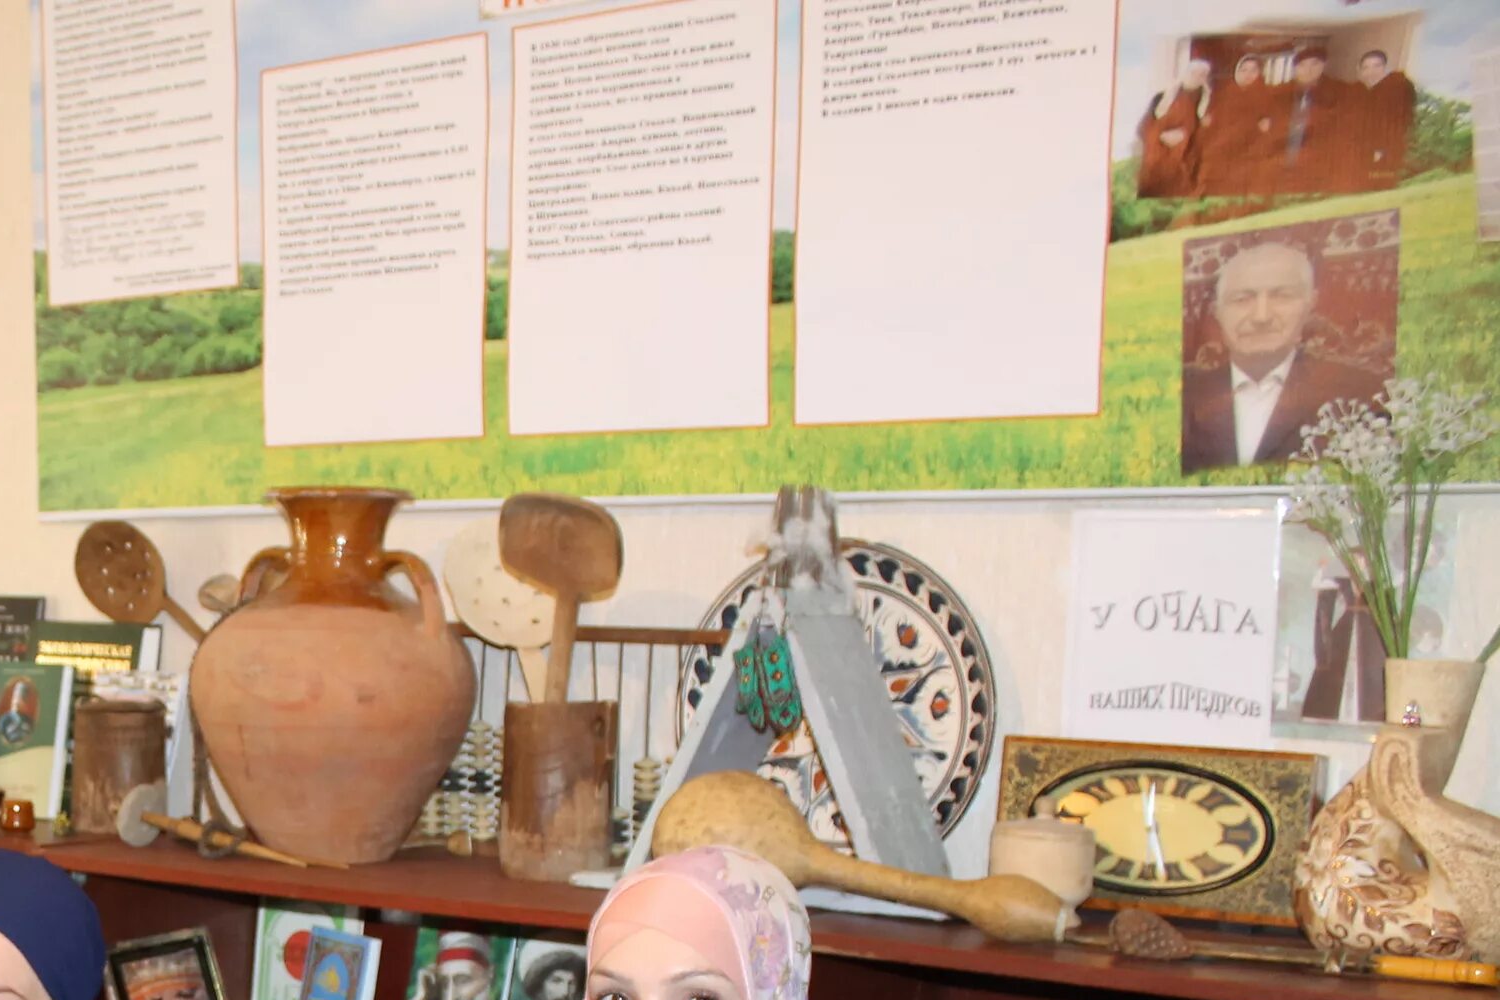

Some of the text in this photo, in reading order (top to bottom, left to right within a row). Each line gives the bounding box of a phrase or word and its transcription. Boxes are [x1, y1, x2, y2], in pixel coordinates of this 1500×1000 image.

[1091, 590, 1262, 634] У ОЧАГА
[1090, 682, 1262, 717] НАШИХ ПРЕДКОВ
